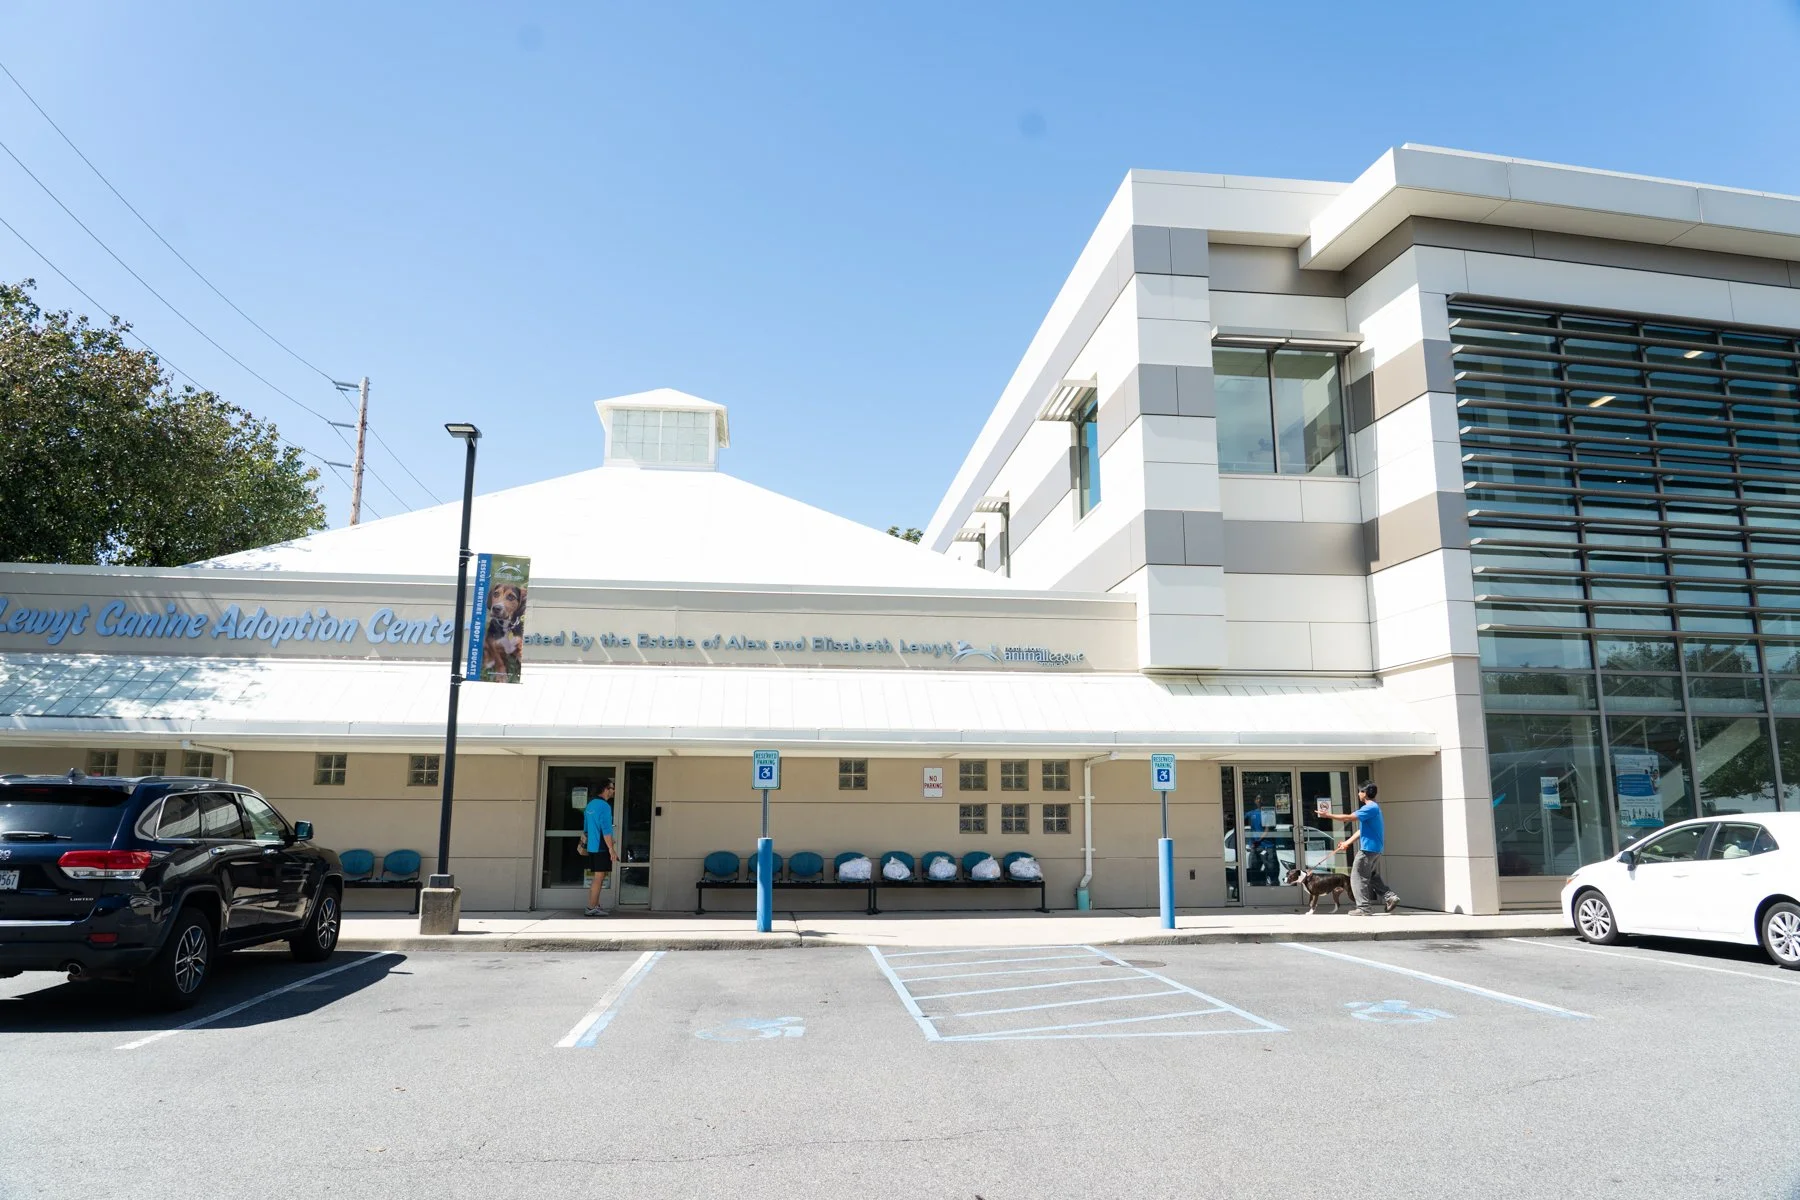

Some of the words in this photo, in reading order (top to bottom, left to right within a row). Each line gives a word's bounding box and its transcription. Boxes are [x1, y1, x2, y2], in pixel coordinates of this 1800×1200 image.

[479, 560, 487, 582] RESCUE
[475, 587, 485, 615] NURTURE
[95, 600, 209, 639] Canine
[210, 603, 359, 648] Adoption
[473, 621, 481, 642] ADOPT
[571, 631, 594, 651] by
[600, 632, 631, 648] the
[637, 633, 696, 649] Estate
[701, 633, 721, 650] of
[725, 635, 769, 651] Alex
[772, 636, 806, 652] and
[811, 637, 893, 654] Elisabeth
[900, 639, 954, 659] Lewyt
[470, 648, 478, 676] EDUCATE
[0, 874, 17, 886] 567
